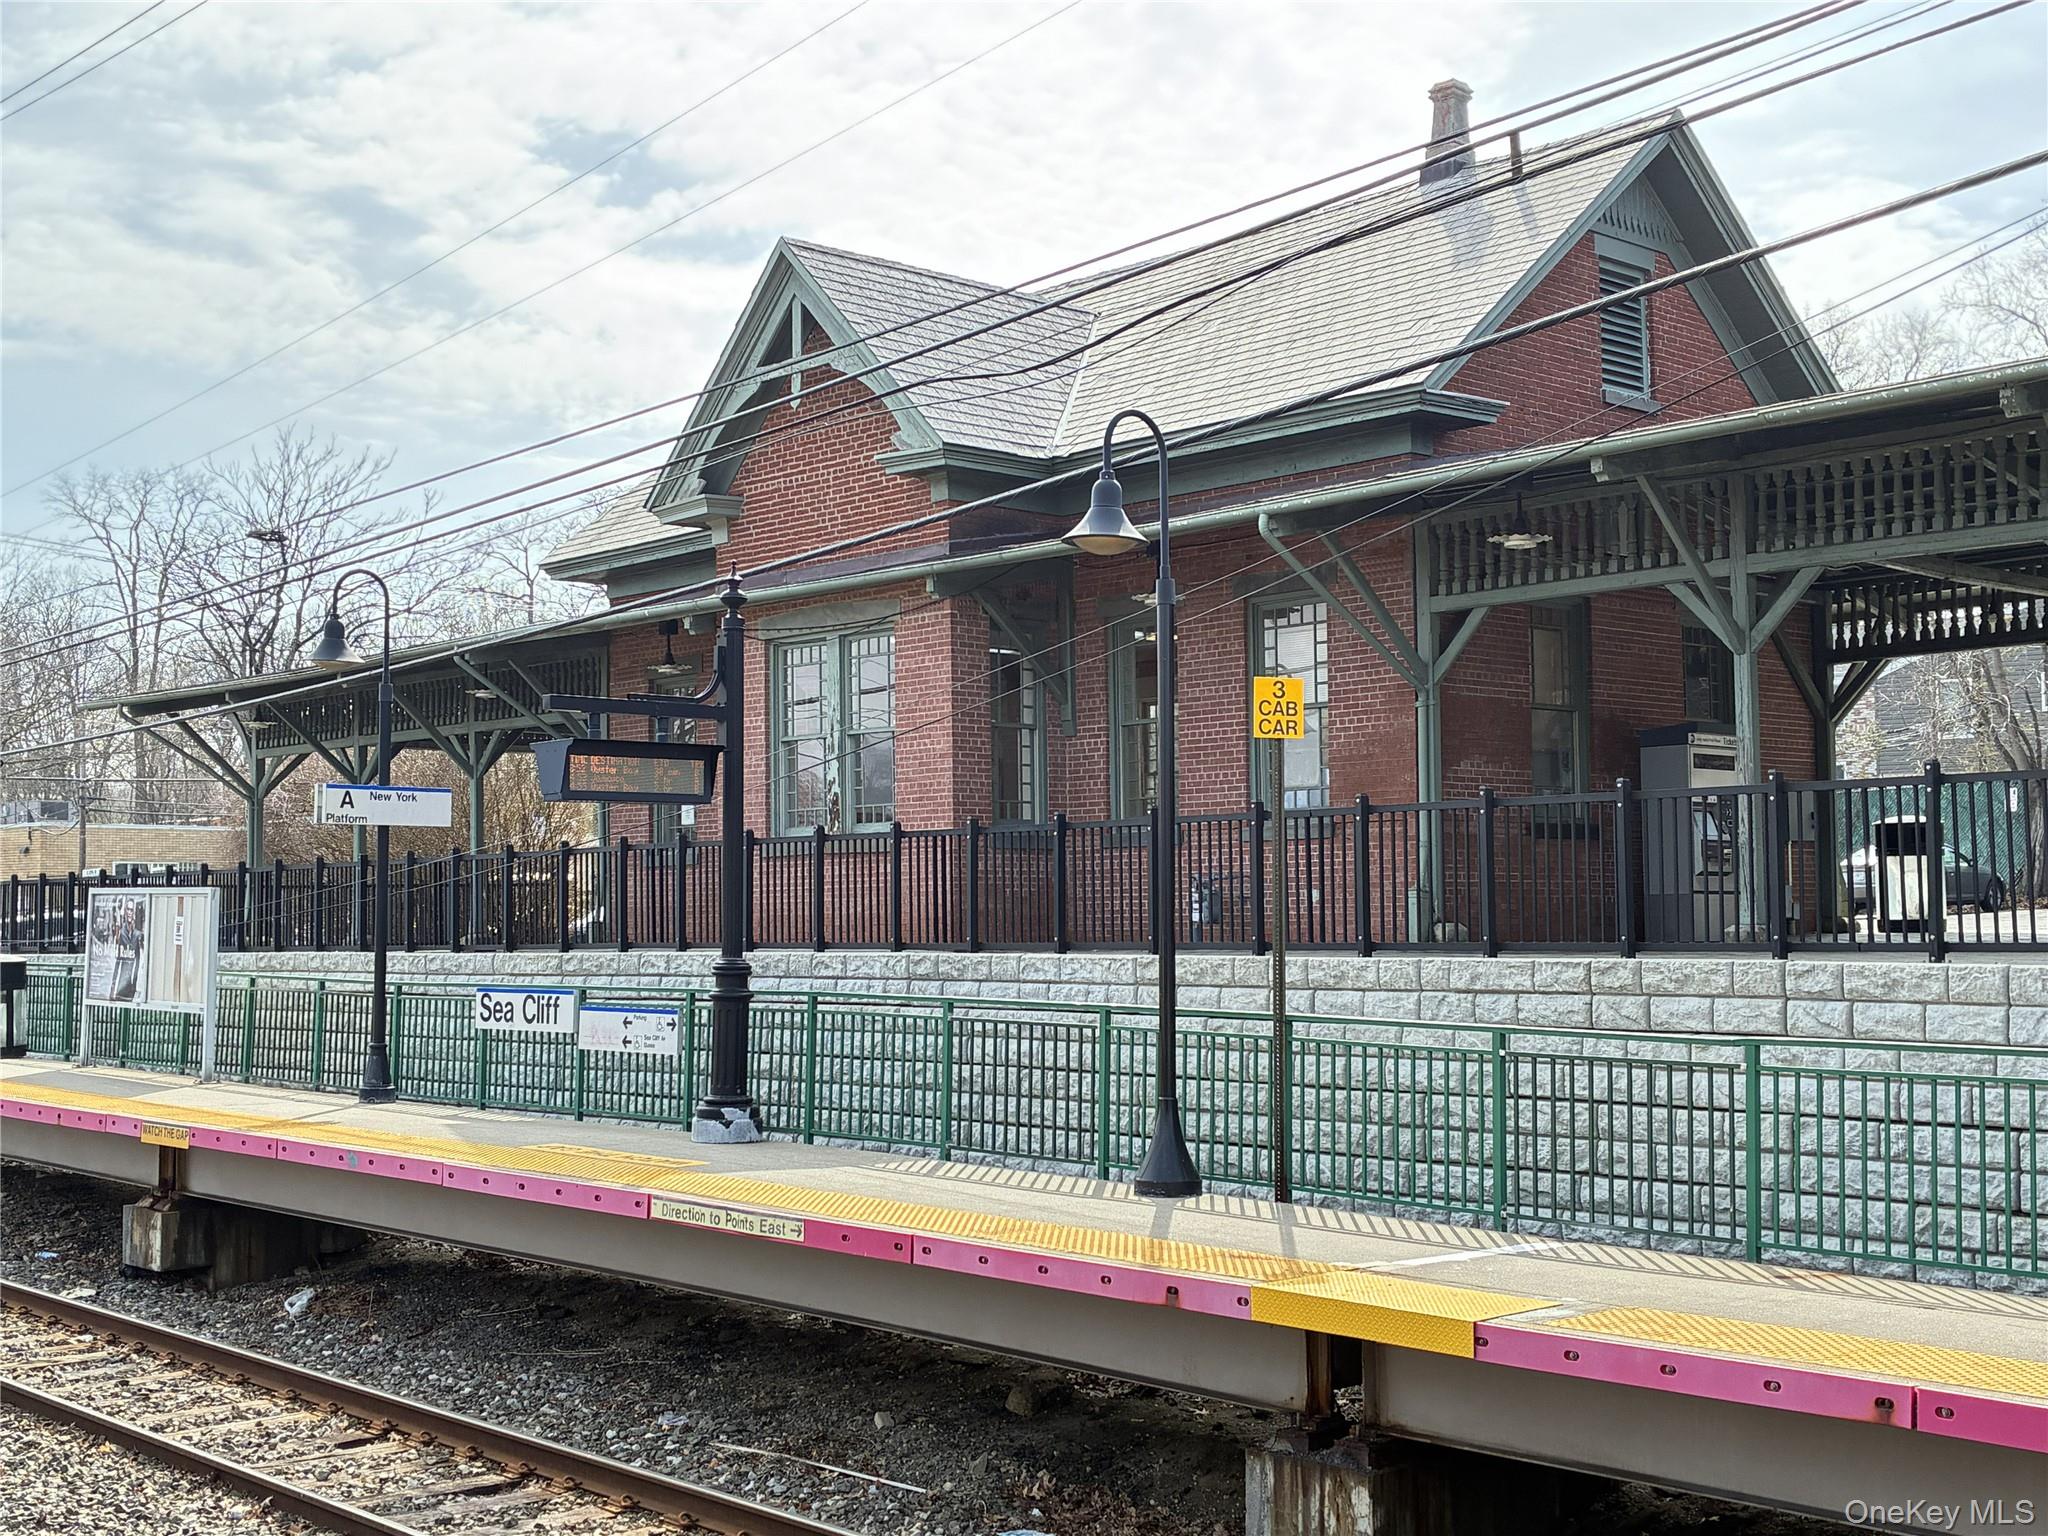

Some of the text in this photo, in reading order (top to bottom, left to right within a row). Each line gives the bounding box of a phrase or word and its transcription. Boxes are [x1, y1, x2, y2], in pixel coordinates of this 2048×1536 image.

[1272, 680, 1286, 699] 3
[1258, 699, 1298, 716] CAB
[1258, 718, 1298, 735] CAR
[340, 790, 354, 809] A
[369, 791, 418, 803] New York
[326, 812, 368, 824] Platform
[480, 993, 560, 1025] Sea Cliff
[143, 1123, 189, 1140] WATCH THE GAP
[661, 1203, 786, 1236] Direction to Points East
